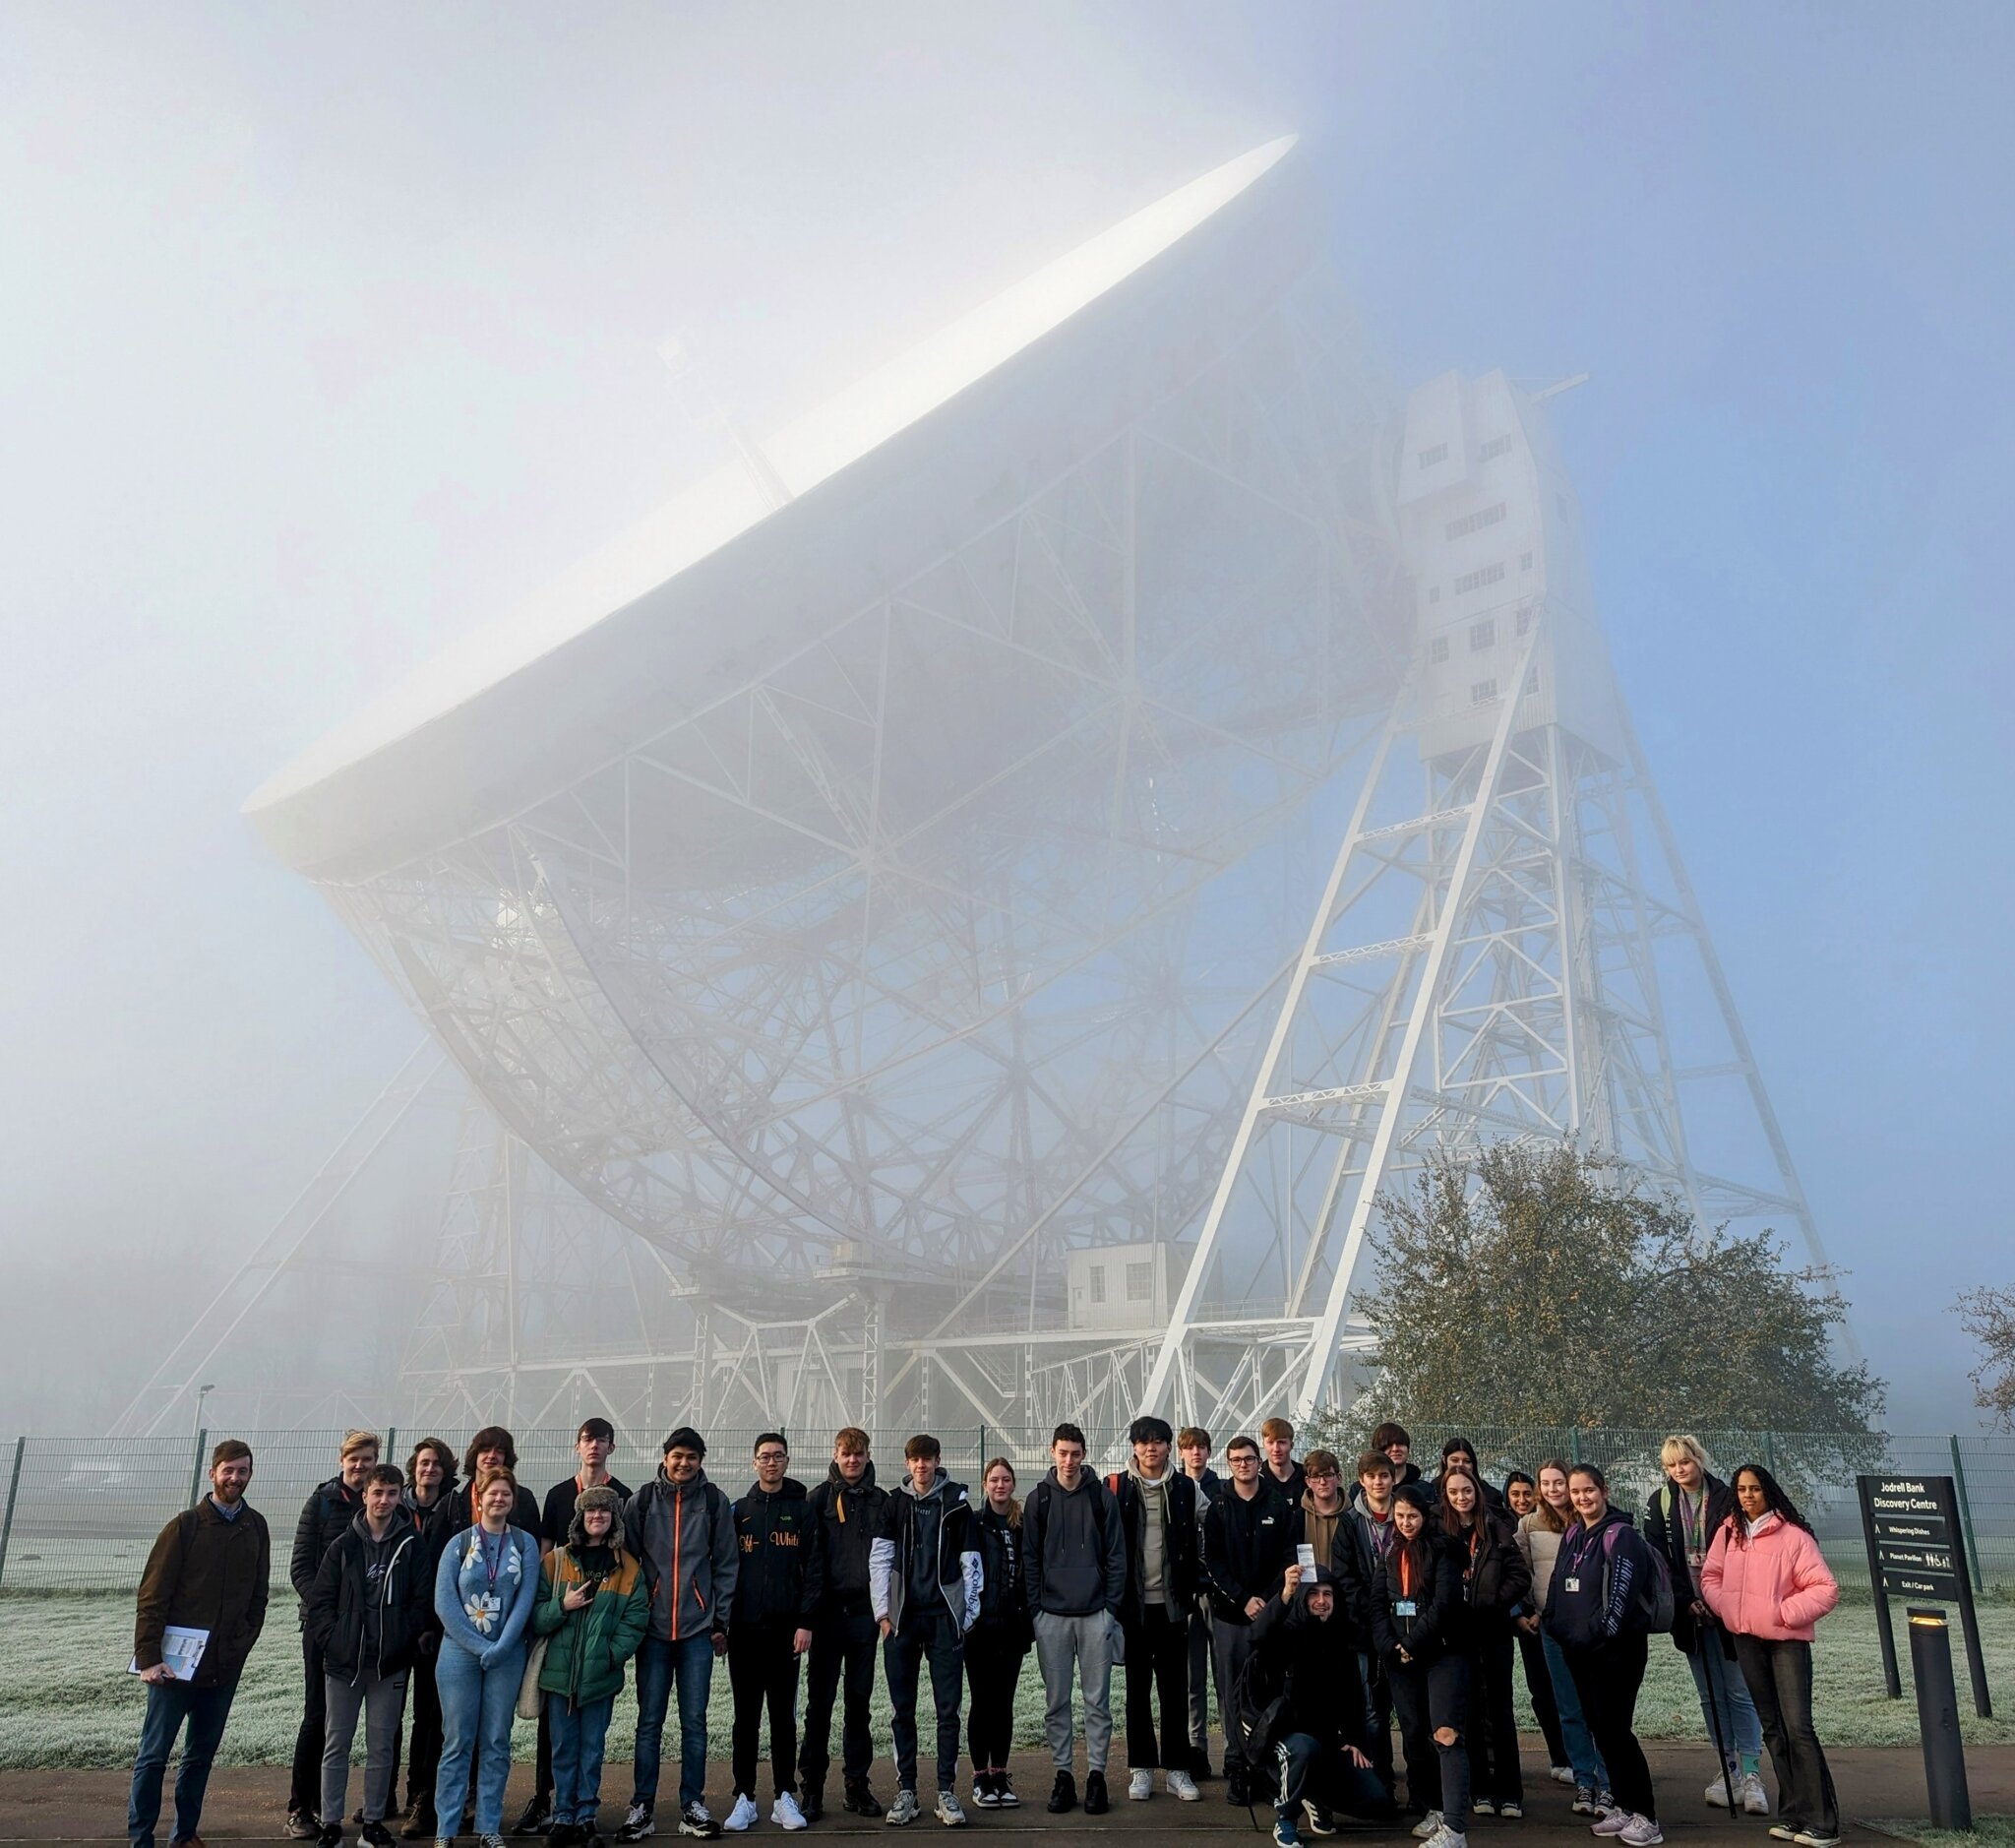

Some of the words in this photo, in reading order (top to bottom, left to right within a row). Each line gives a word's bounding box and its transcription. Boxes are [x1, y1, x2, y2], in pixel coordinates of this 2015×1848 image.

[1880, 1481, 1906, 1493] Jodrell
[1905, 1482, 1925, 1494] Bank
[1873, 1497, 1910, 1511] Discovery
[1910, 1498, 1938, 1510] Centre
[1888, 1525, 1914, 1536] Whispering
[1914, 1527, 1930, 1536] Dishes
[1914, 1581, 1923, 1590] Car
[1923, 1583, 1935, 1592] park
